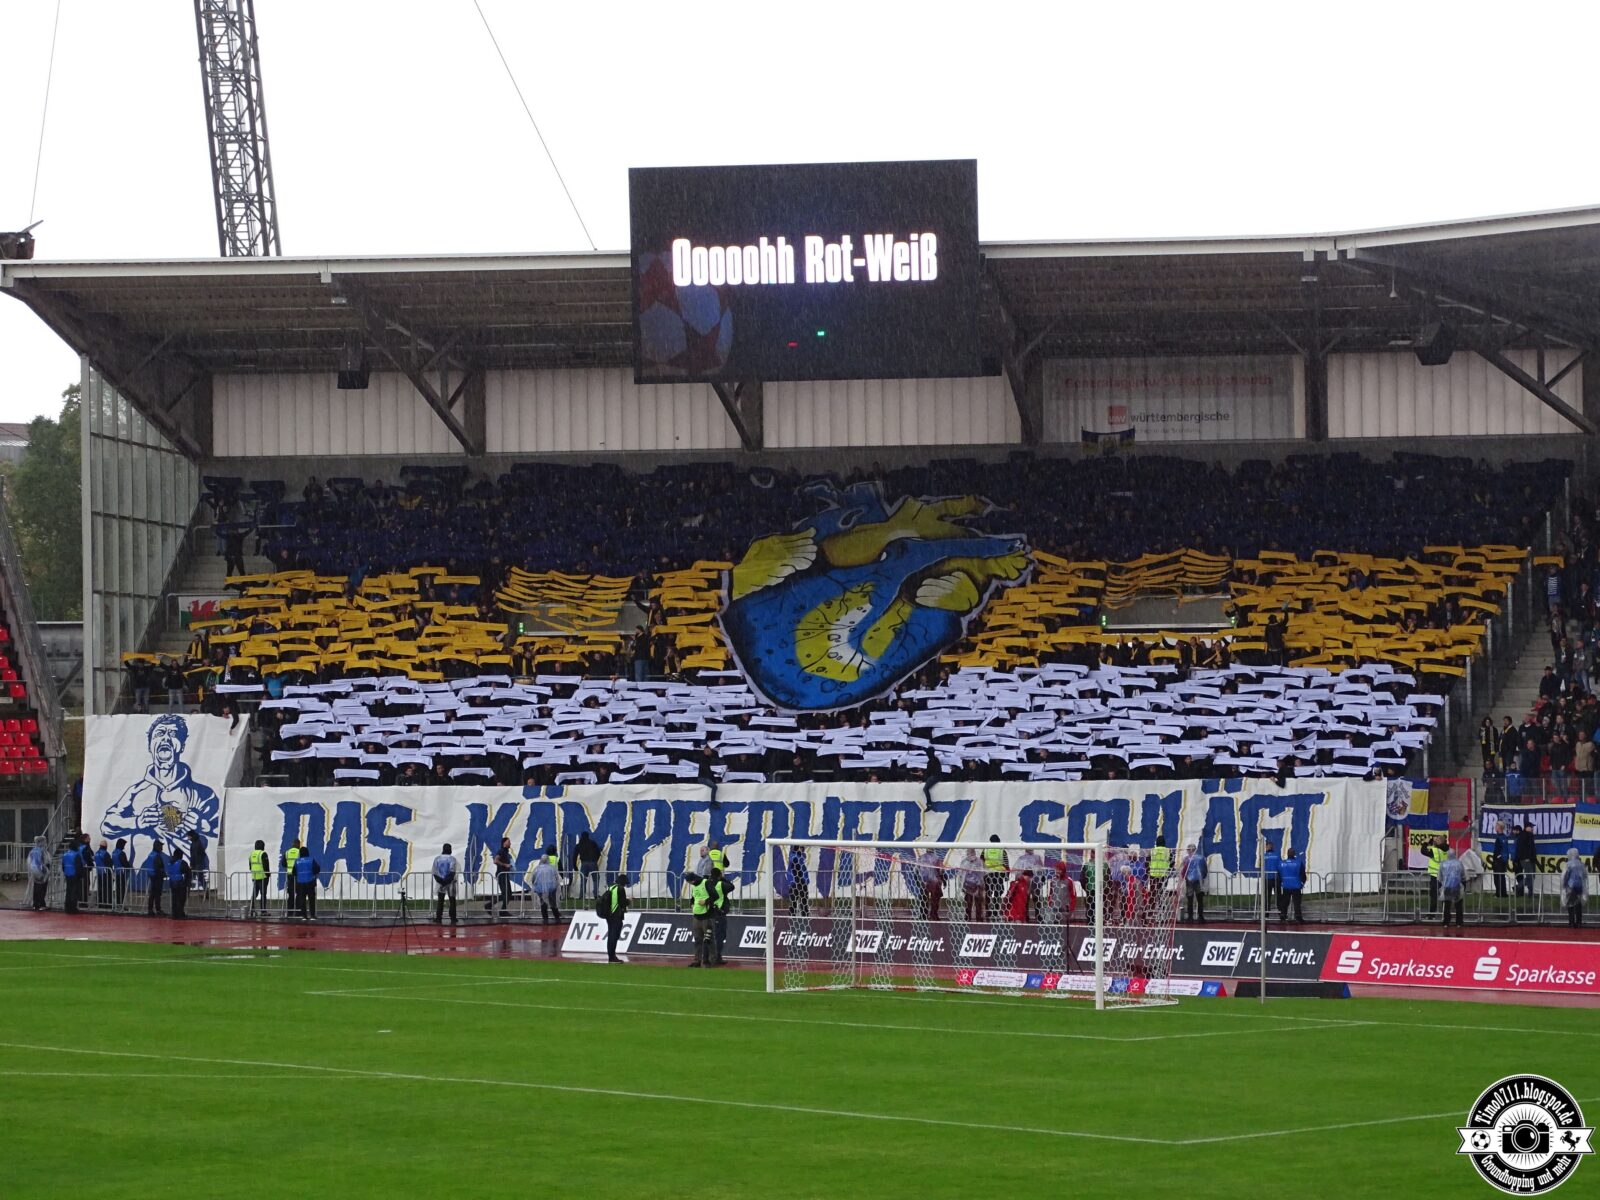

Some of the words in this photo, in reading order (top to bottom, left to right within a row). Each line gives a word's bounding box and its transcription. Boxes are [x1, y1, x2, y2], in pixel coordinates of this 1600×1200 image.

[672, 235, 795, 287] Ooooohh
[805, 232, 938, 283] Rot-Weiß
[1130, 410, 1230, 424] württembergische
[1529, 811, 1573, 835] MIND
[277, 800, 417, 891] DAS
[464, 784, 978, 899] KÄMPFERHERZ
[569, 922, 632, 941] NT.G
[642, 922, 666, 941] SWE
[672, 927, 692, 943] Für
[776, 931, 797, 946] Für
[797, 932, 833, 948] Erfurt.
[885, 935, 907, 951] Für
[907, 936, 945, 952] Erfurt.
[964, 937, 992, 952] SWE
[1000, 939, 1021, 954] Für
[1021, 939, 1063, 956] Erfurt.
[1119, 943, 1143, 959] Für
[1143, 943, 1185, 961] Erfurt.
[1207, 945, 1237, 962] SWE
[1247, 947, 1271, 963] Für
[1272, 948, 1316, 965] Erfurt.
[1368, 957, 1454, 979] Sparkasse
[1506, 964, 1596, 986] Sparkasse
